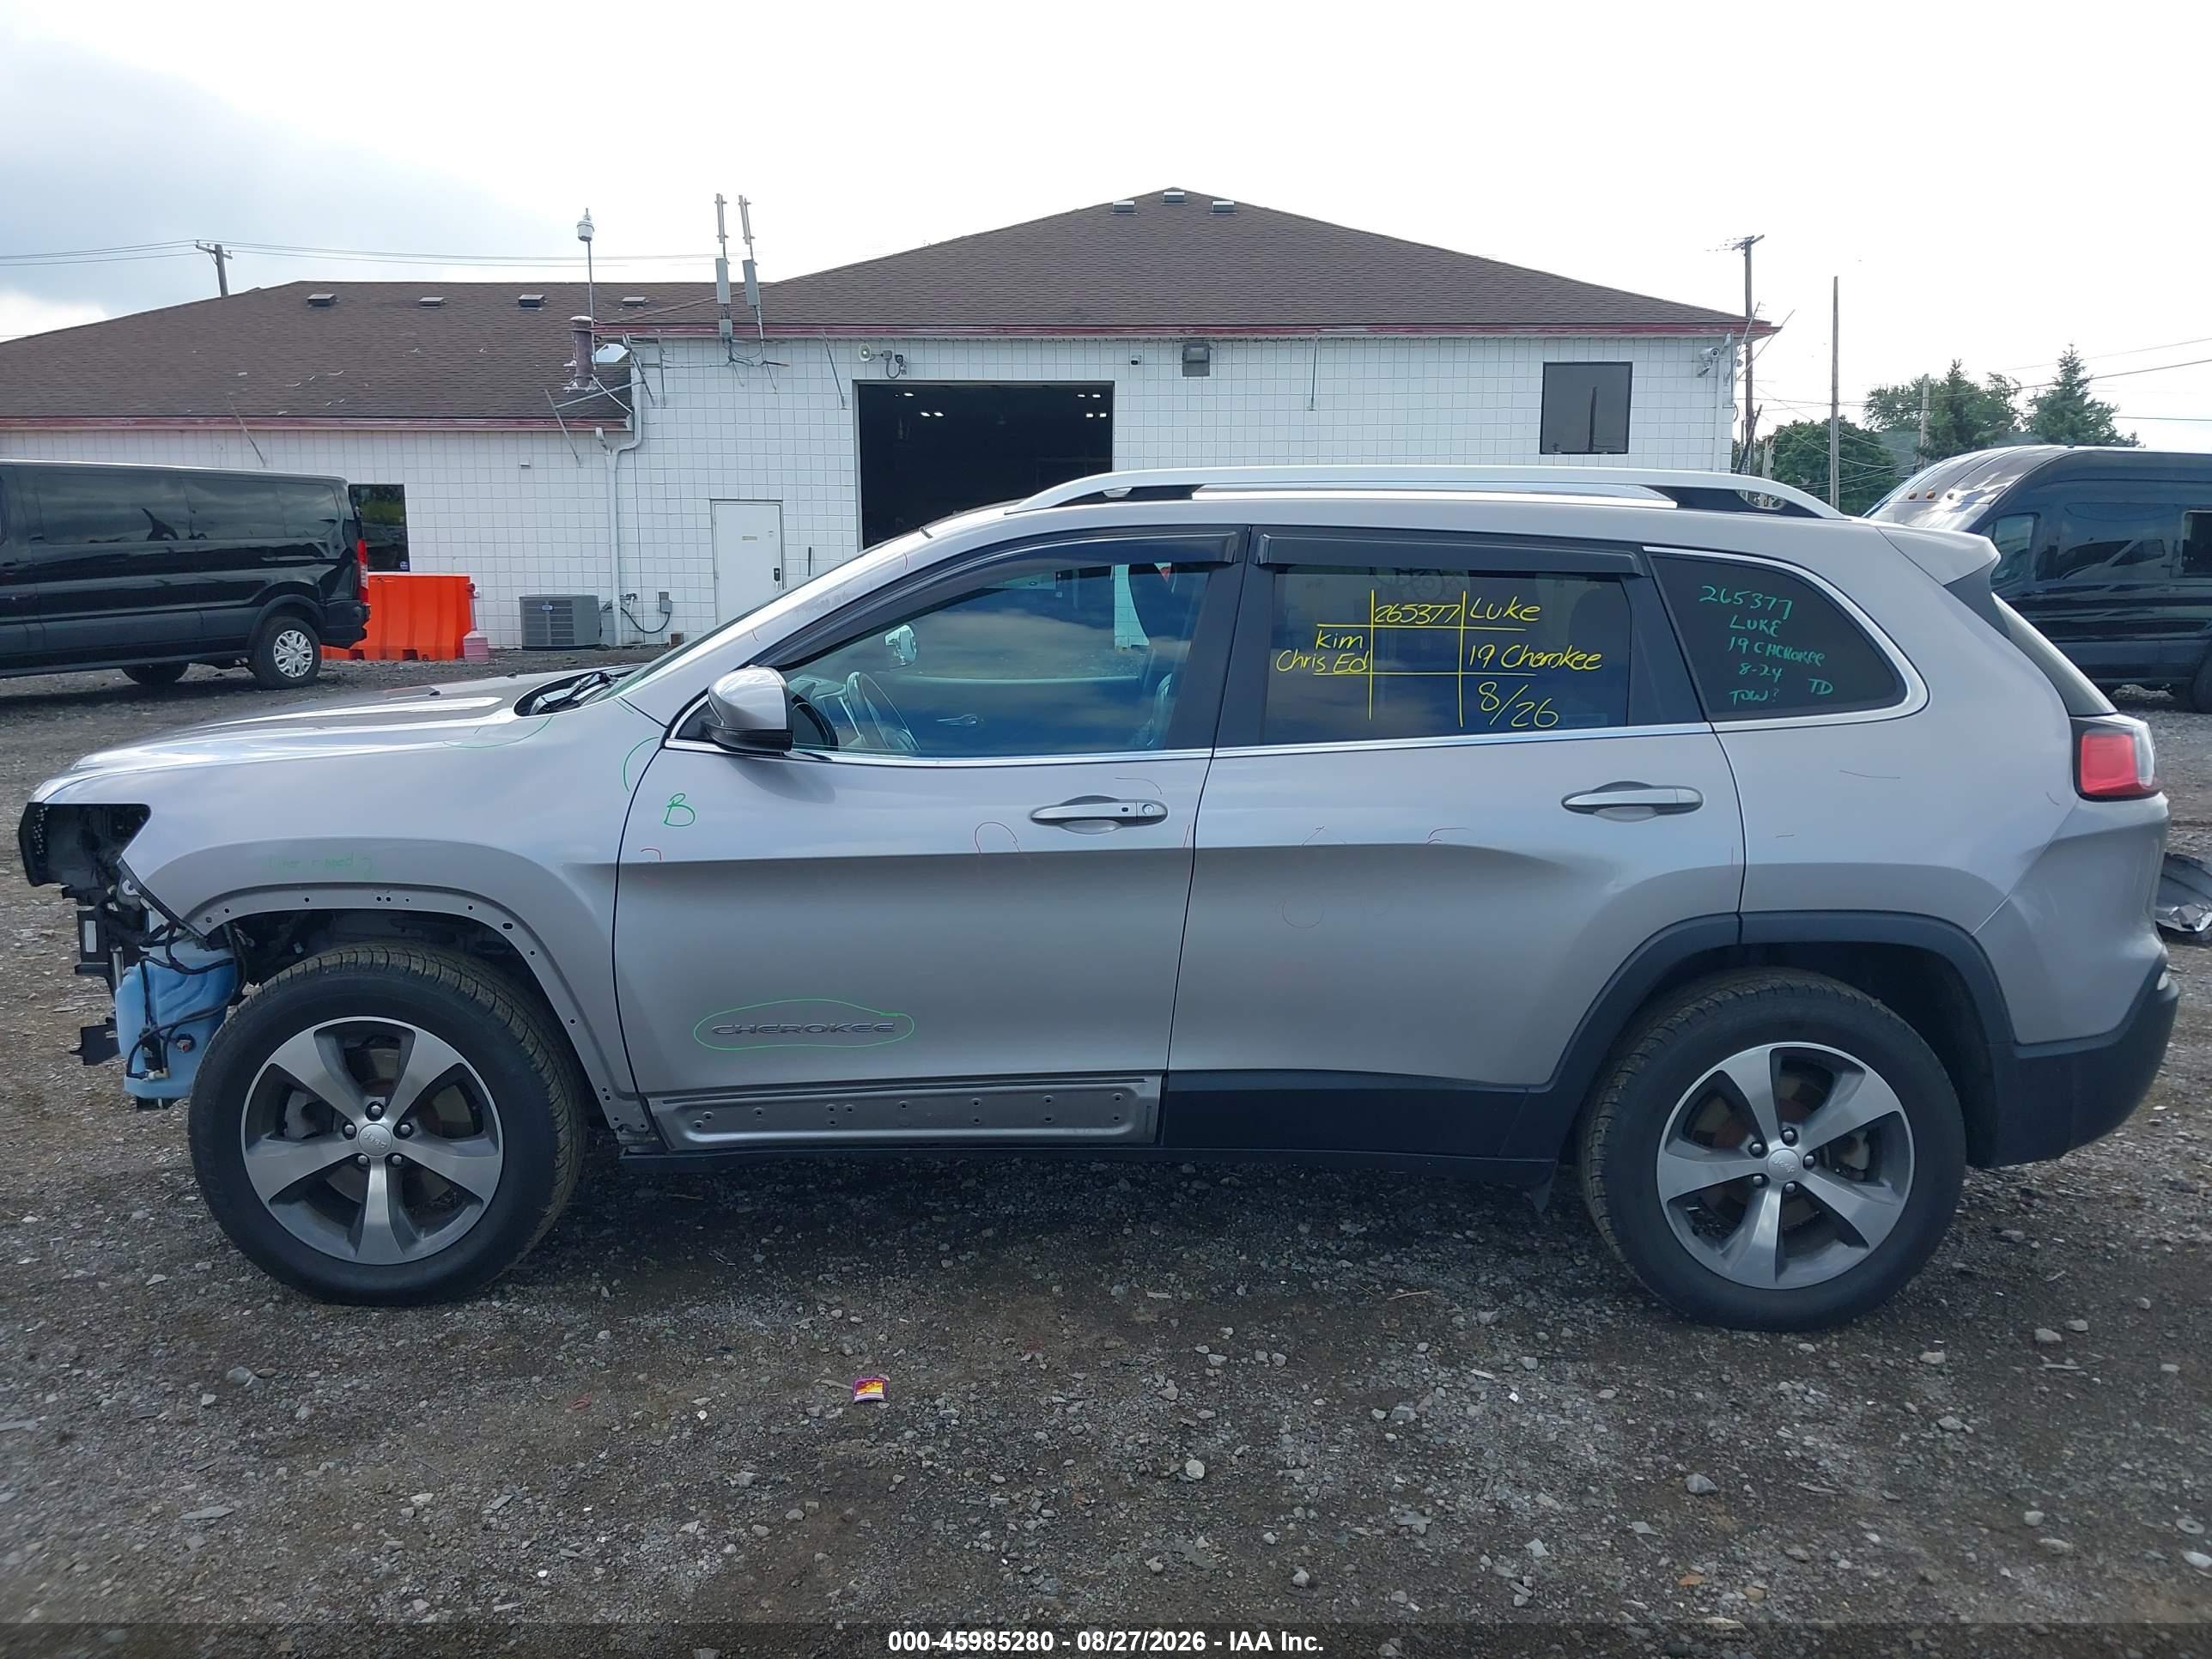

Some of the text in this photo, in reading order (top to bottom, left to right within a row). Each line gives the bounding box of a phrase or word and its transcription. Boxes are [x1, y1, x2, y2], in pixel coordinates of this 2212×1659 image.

[1374, 603, 1461, 625] 265377
[1469, 596, 1541, 623] Luke
[1699, 585, 1792, 620] 265377
[1729, 615, 1782, 638] LUKE
[1728, 636, 1748, 653] 19
[1276, 649, 1370, 674] Chris Ed
[1469, 644, 1602, 672] 19 Cherokee
[1738, 662, 1783, 683] 8-24
[1808, 678, 1834, 696] TD
[1478, 682, 1559, 728] 8/26
[664, 793, 696, 828] B
[711, 1023, 895, 1035] CHEROKEE
[363, 1132, 388, 1149] Jeep
